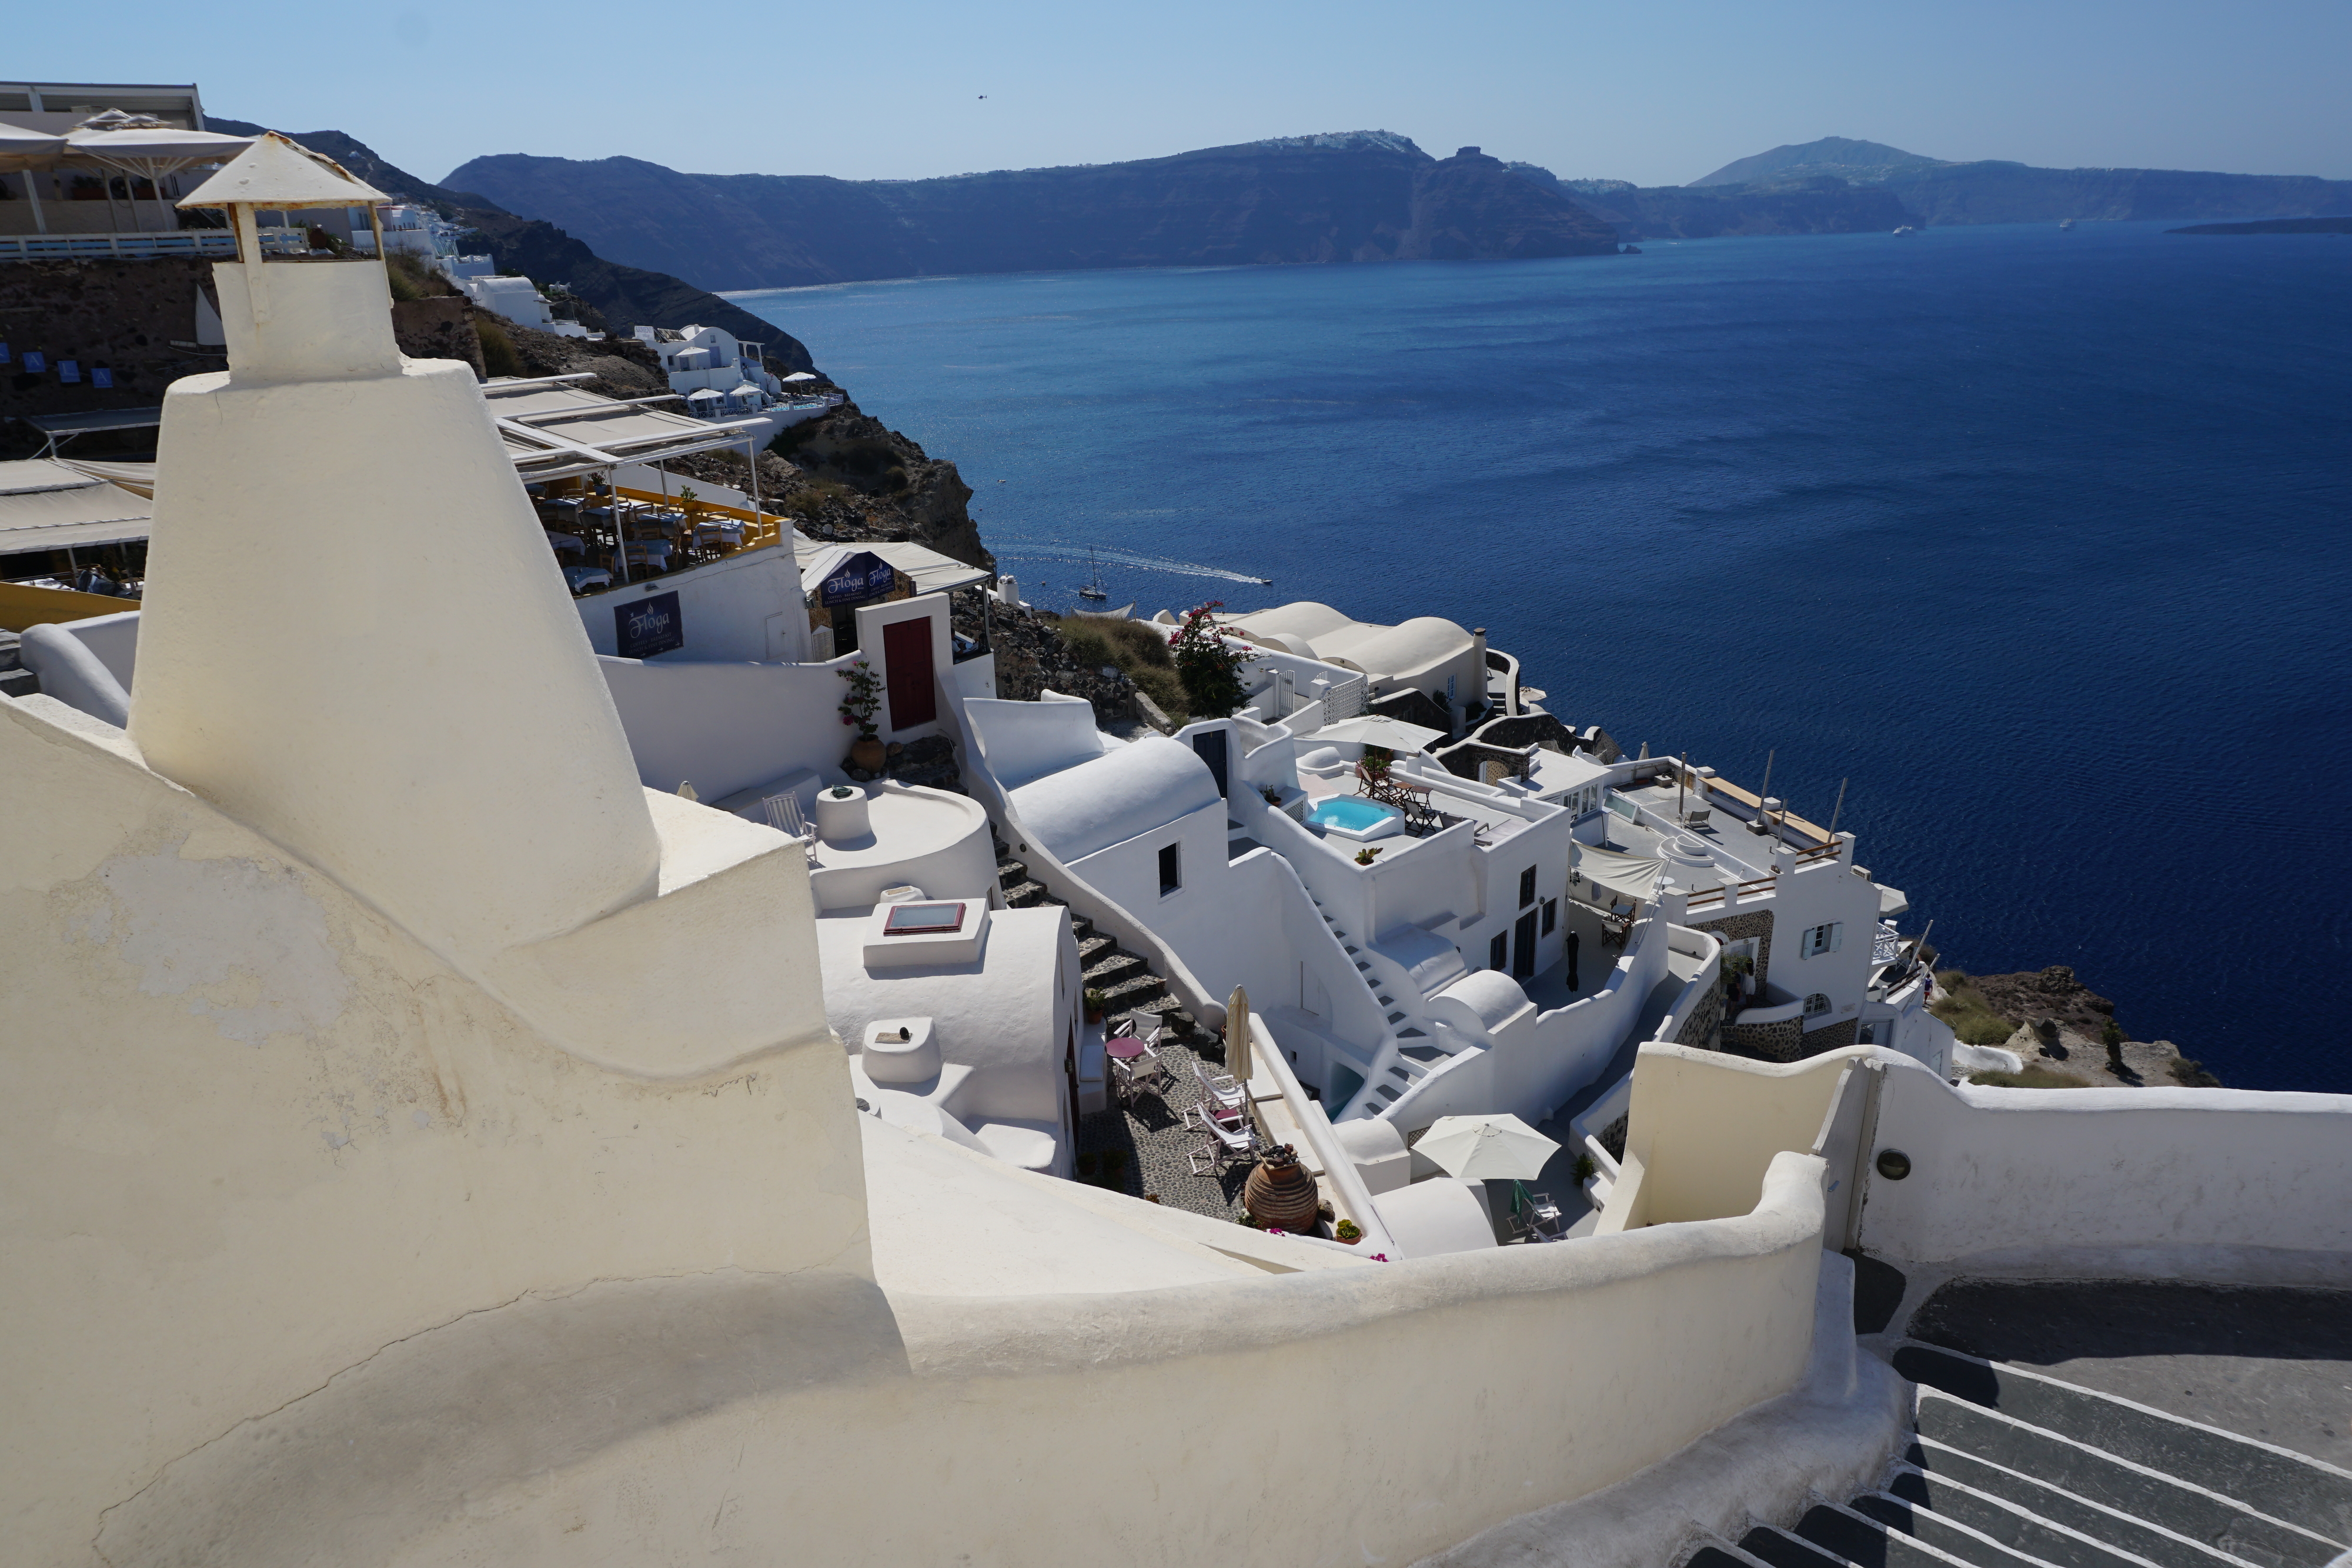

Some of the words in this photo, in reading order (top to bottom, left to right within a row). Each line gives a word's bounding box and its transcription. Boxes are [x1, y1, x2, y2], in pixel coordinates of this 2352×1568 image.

[827, 577, 864, 594] Floga
[868, 568, 891, 586] Floga
[629, 613, 670, 638] Floga
[650, 632, 672, 642] BREAKFAST
[658, 637, 674, 646] DINING
